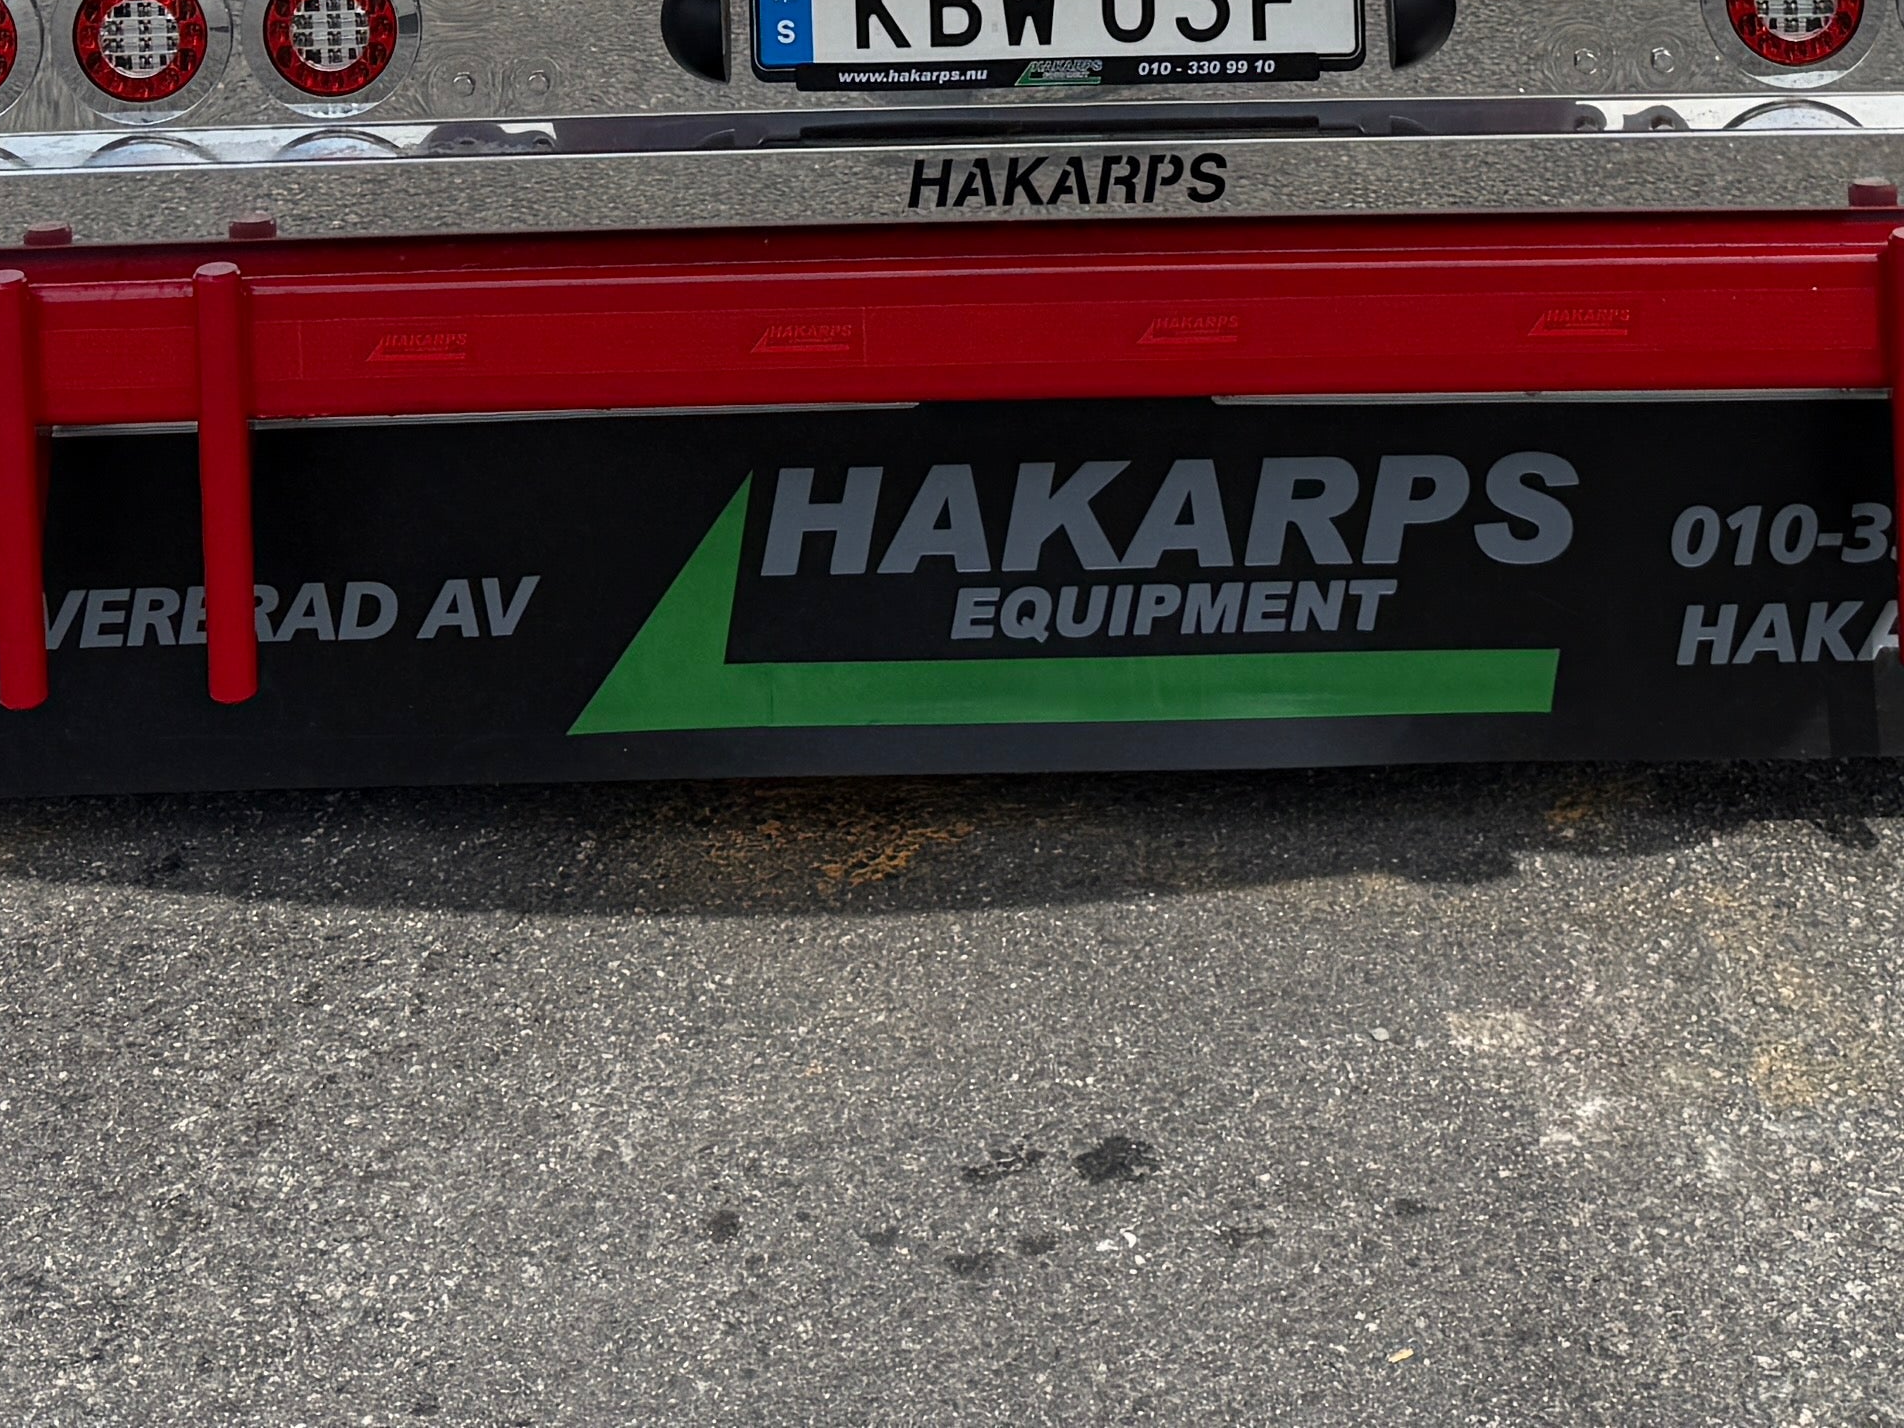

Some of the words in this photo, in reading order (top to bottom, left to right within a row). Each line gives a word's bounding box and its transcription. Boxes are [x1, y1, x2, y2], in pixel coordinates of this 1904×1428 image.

[777, 18, 796, 45] S
[838, 68, 988, 85] www.hakarps.nu
[1138, 62, 1172, 76] 010
[1187, 60, 1221, 75] 330
[1226, 60, 1249, 74] 99
[1254, 59, 1276, 73] 10
[908, 152, 1227, 209] HAKARPS
[760, 451, 1580, 577] HAKARPS
[416, 575, 542, 640] AV
[949, 578, 1398, 644] EQUIPMENT
